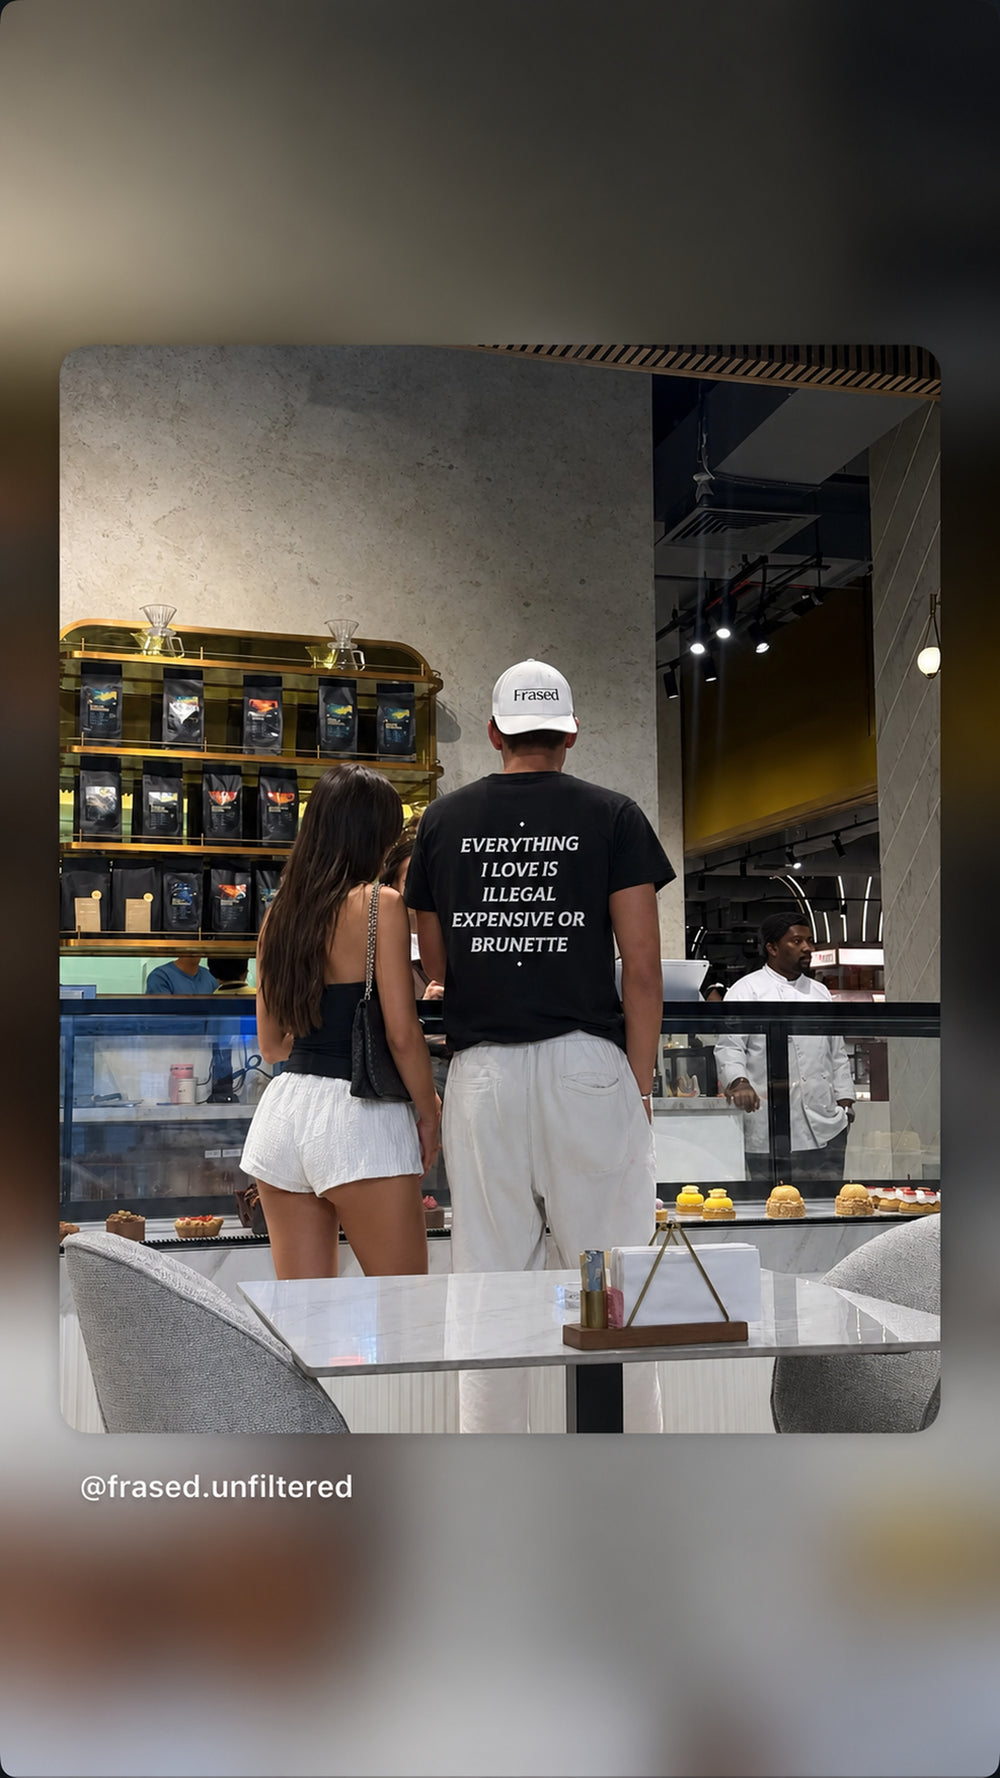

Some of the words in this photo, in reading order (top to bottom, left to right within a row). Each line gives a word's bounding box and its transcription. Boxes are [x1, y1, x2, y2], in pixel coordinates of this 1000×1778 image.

[514, 688, 559, 702] Frased
[460, 836, 579, 853] EVERYTHING
[481, 861, 489, 877] I
[491, 861, 538, 877] LOVE
[542, 861, 559, 877] IS
[482, 886, 557, 902] ILLEGAL
[452, 911, 554, 928] EXPENSIVE
[557, 911, 586, 928] OR
[470, 937, 568, 953] BRUNETTE
